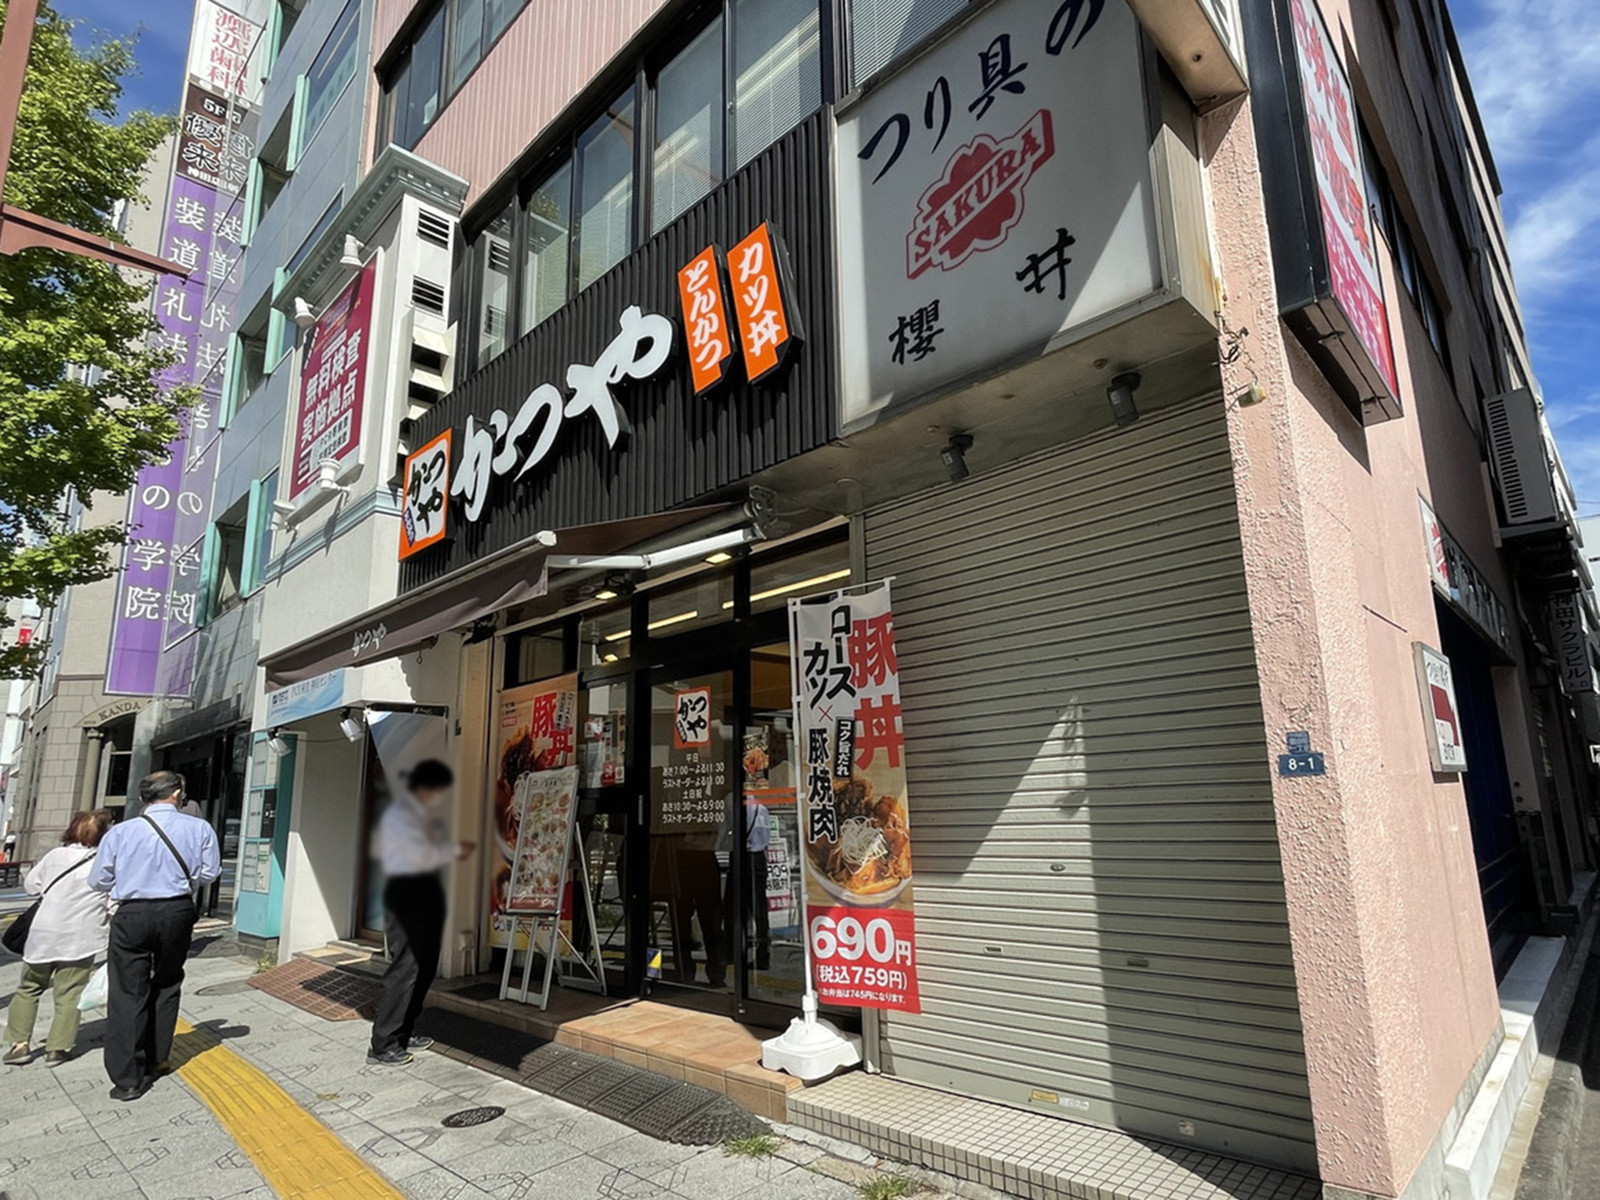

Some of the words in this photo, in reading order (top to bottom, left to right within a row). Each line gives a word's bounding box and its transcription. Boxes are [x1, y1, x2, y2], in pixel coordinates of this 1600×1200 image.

[914, 125, 1042, 264] SAKURA
[685, 260, 723, 371] とんかつ
[738, 243, 782, 357] カツ丼
[450, 304, 674, 523] かつや
[407, 450, 446, 533] かつや
[826, 605, 857, 701] ロース
[848, 612, 906, 771] 豚丼
[98, 701, 140, 721] KANDA
[677, 696, 707, 739] かつや
[808, 728, 836, 842] 豚焼肉
[1288, 757, 1314, 771] 8-1
[811, 915, 912, 966] 690円
[815, 964, 908, 991] (税込759円)
